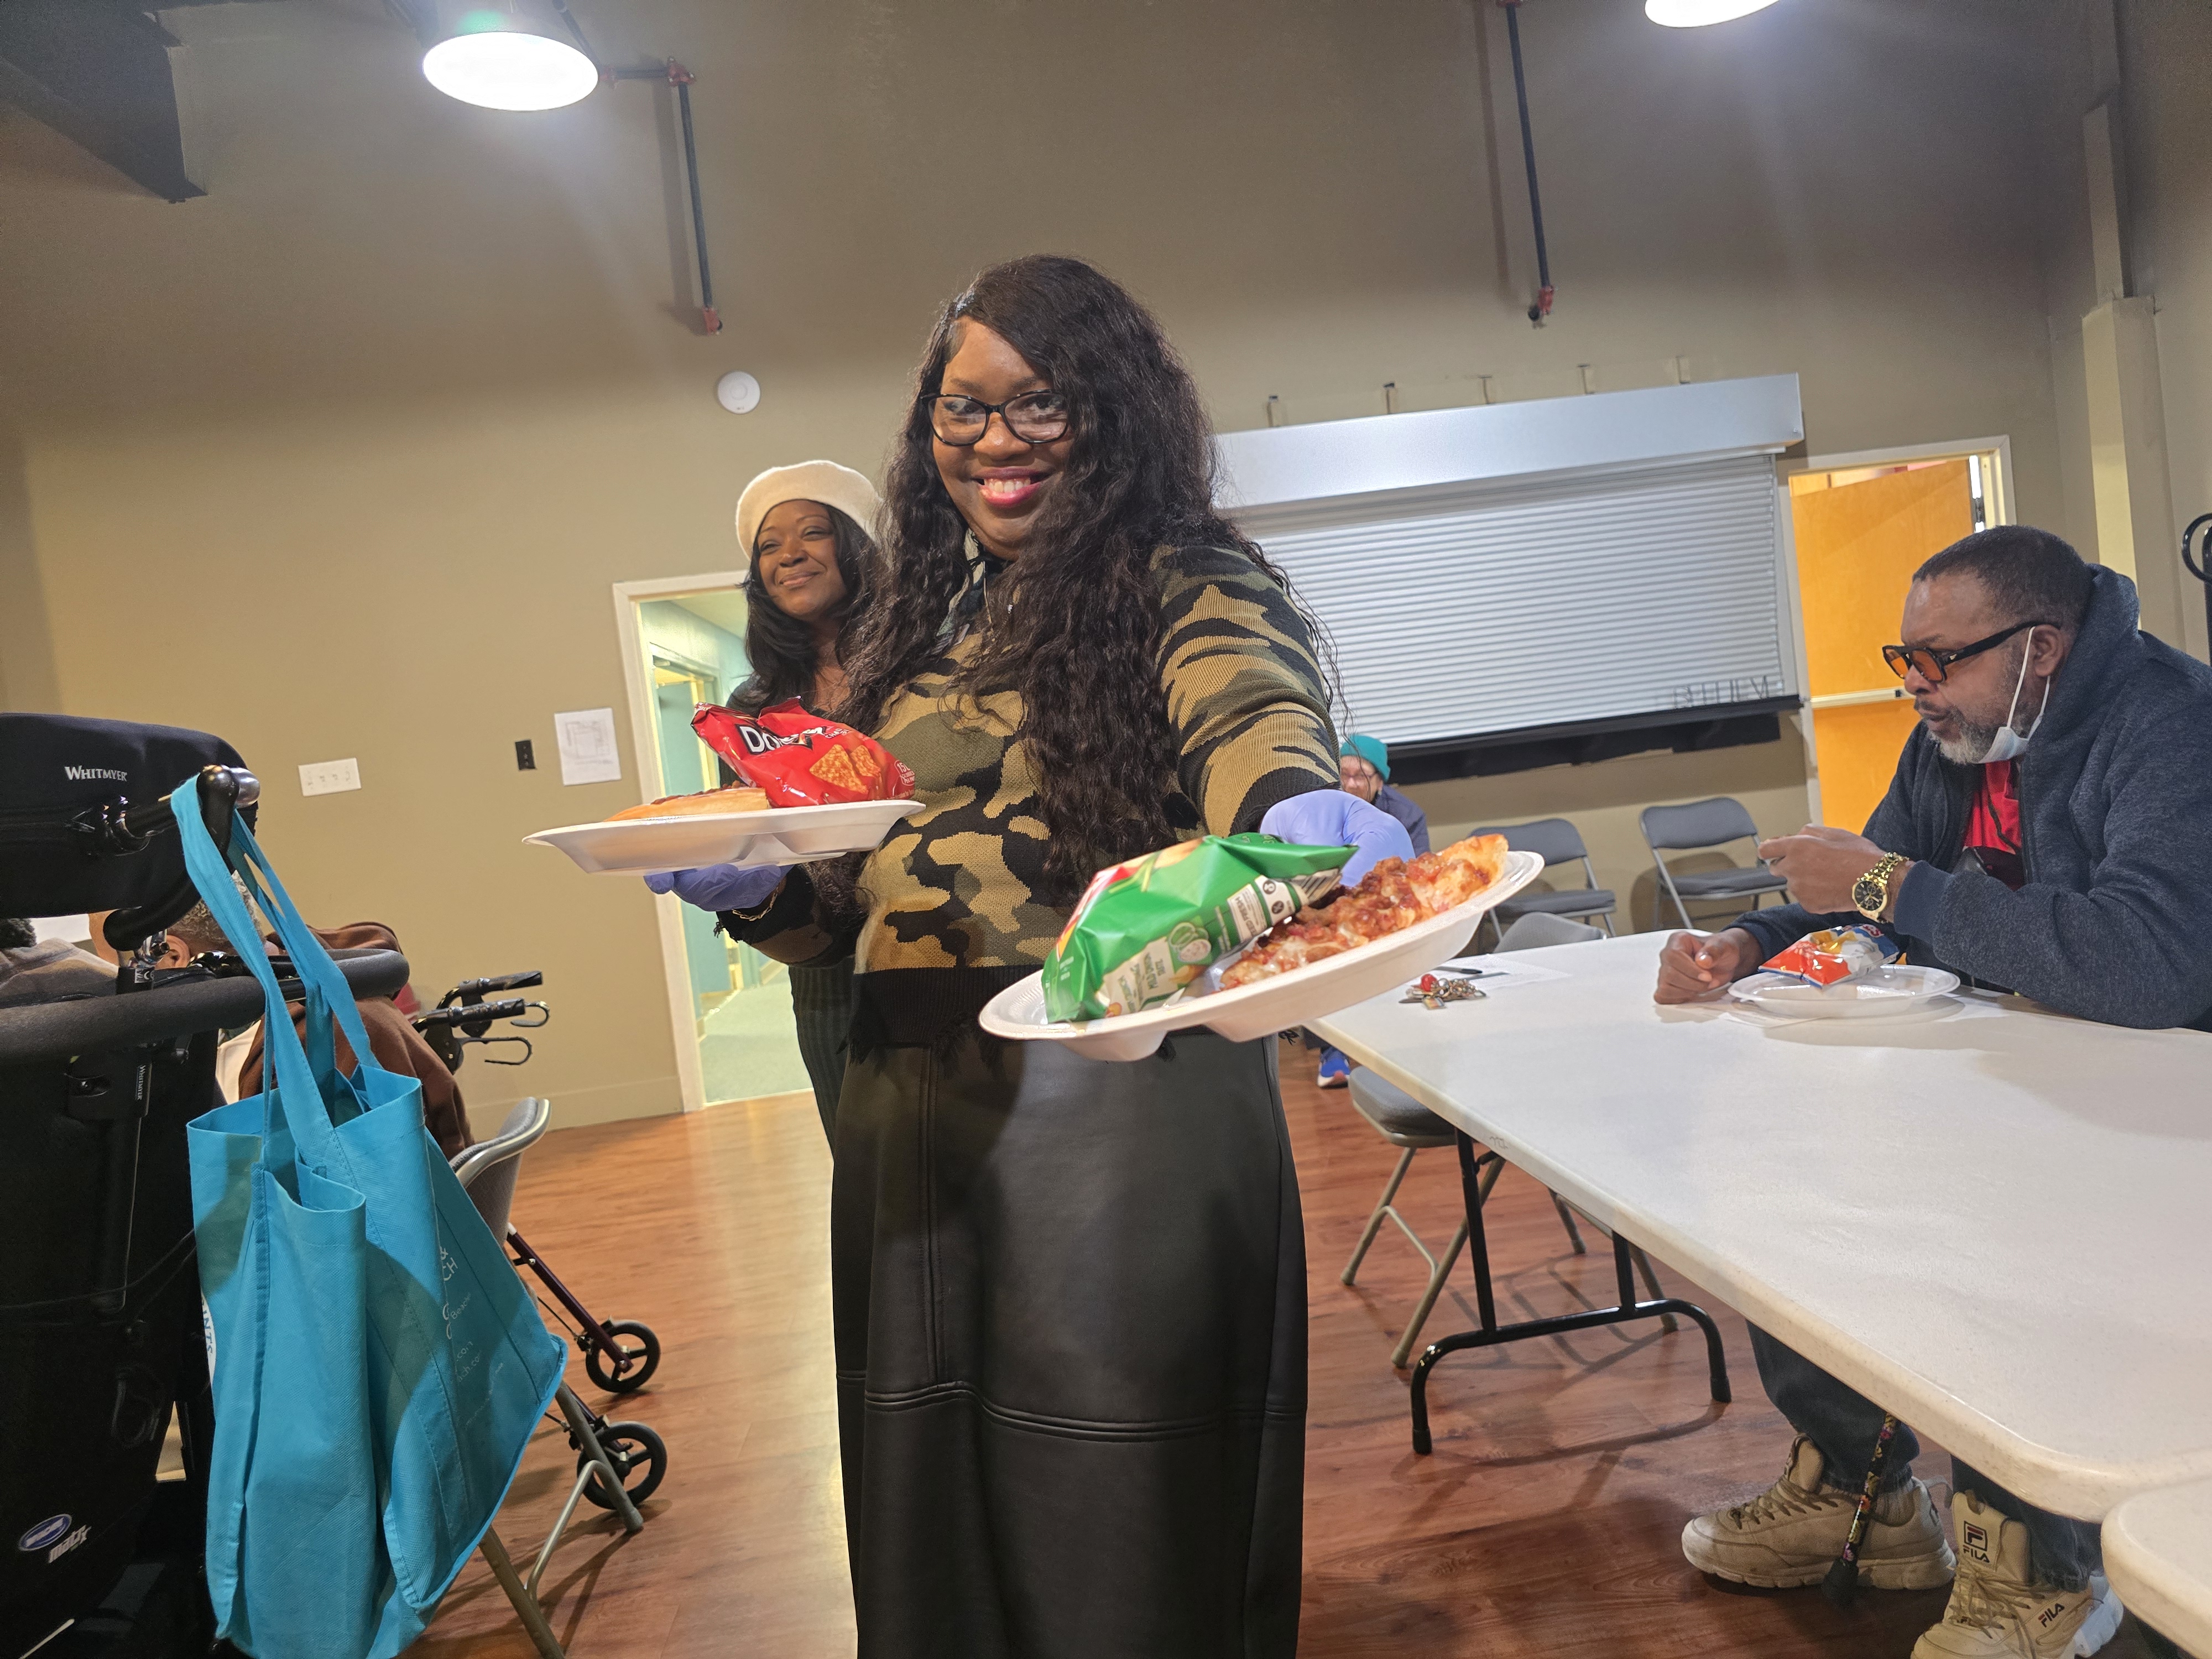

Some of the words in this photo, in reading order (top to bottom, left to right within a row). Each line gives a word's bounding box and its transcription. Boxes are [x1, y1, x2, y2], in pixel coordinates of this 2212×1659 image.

[64, 765, 127, 781] WHITMYER
[1963, 1545, 1990, 1563] FILA
[2038, 1603, 2065, 1628] FILA
